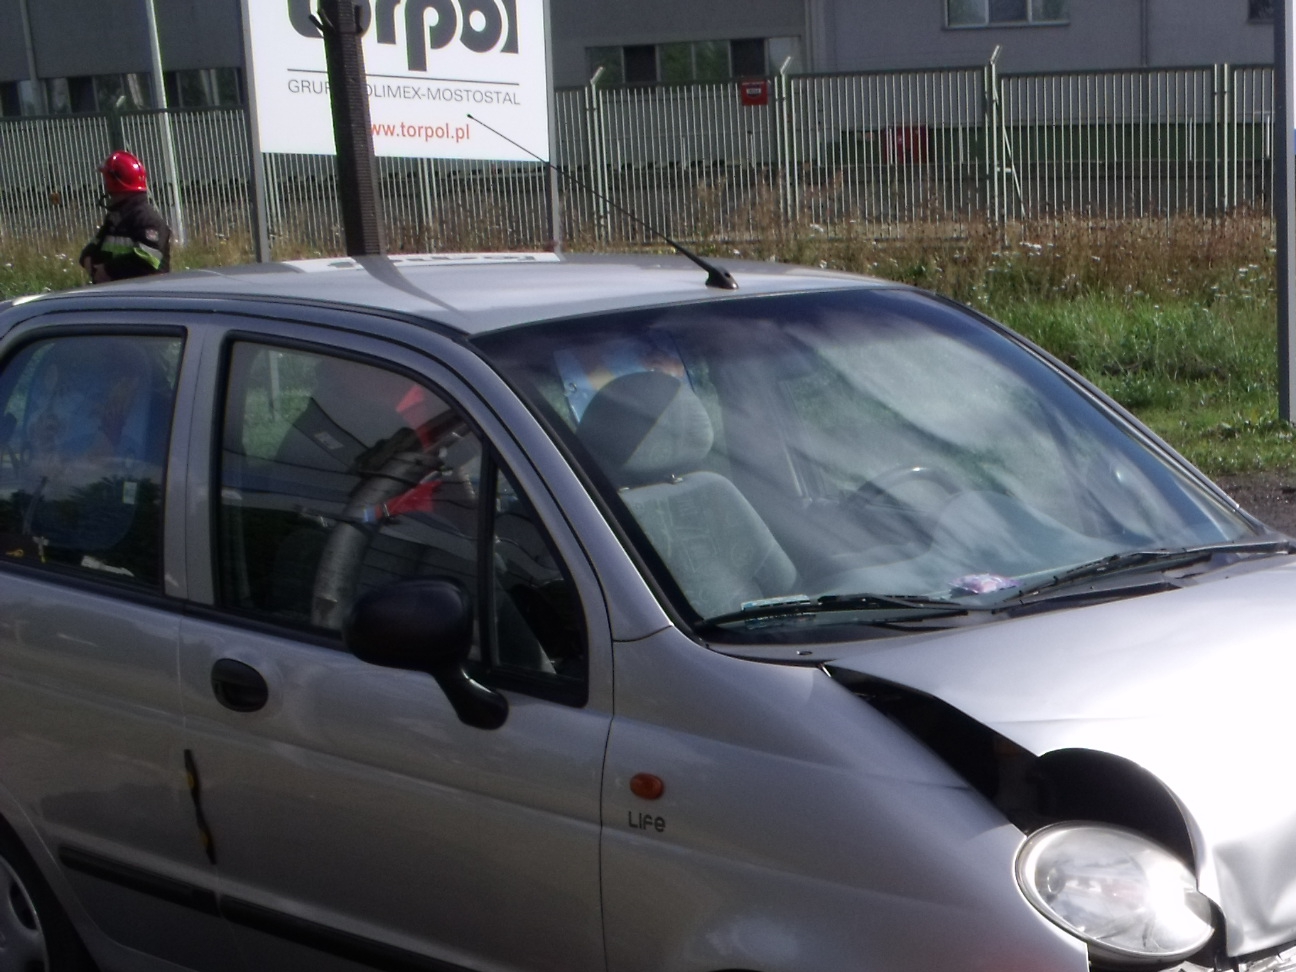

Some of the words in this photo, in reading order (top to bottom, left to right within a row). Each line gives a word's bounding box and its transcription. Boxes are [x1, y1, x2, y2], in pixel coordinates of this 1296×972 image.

[287, 79, 329, 95] GRU
[365, 82, 520, 105] OLIMEX-MOSTOSTAL
[371, 121, 470, 143] ww.torpol.pl
